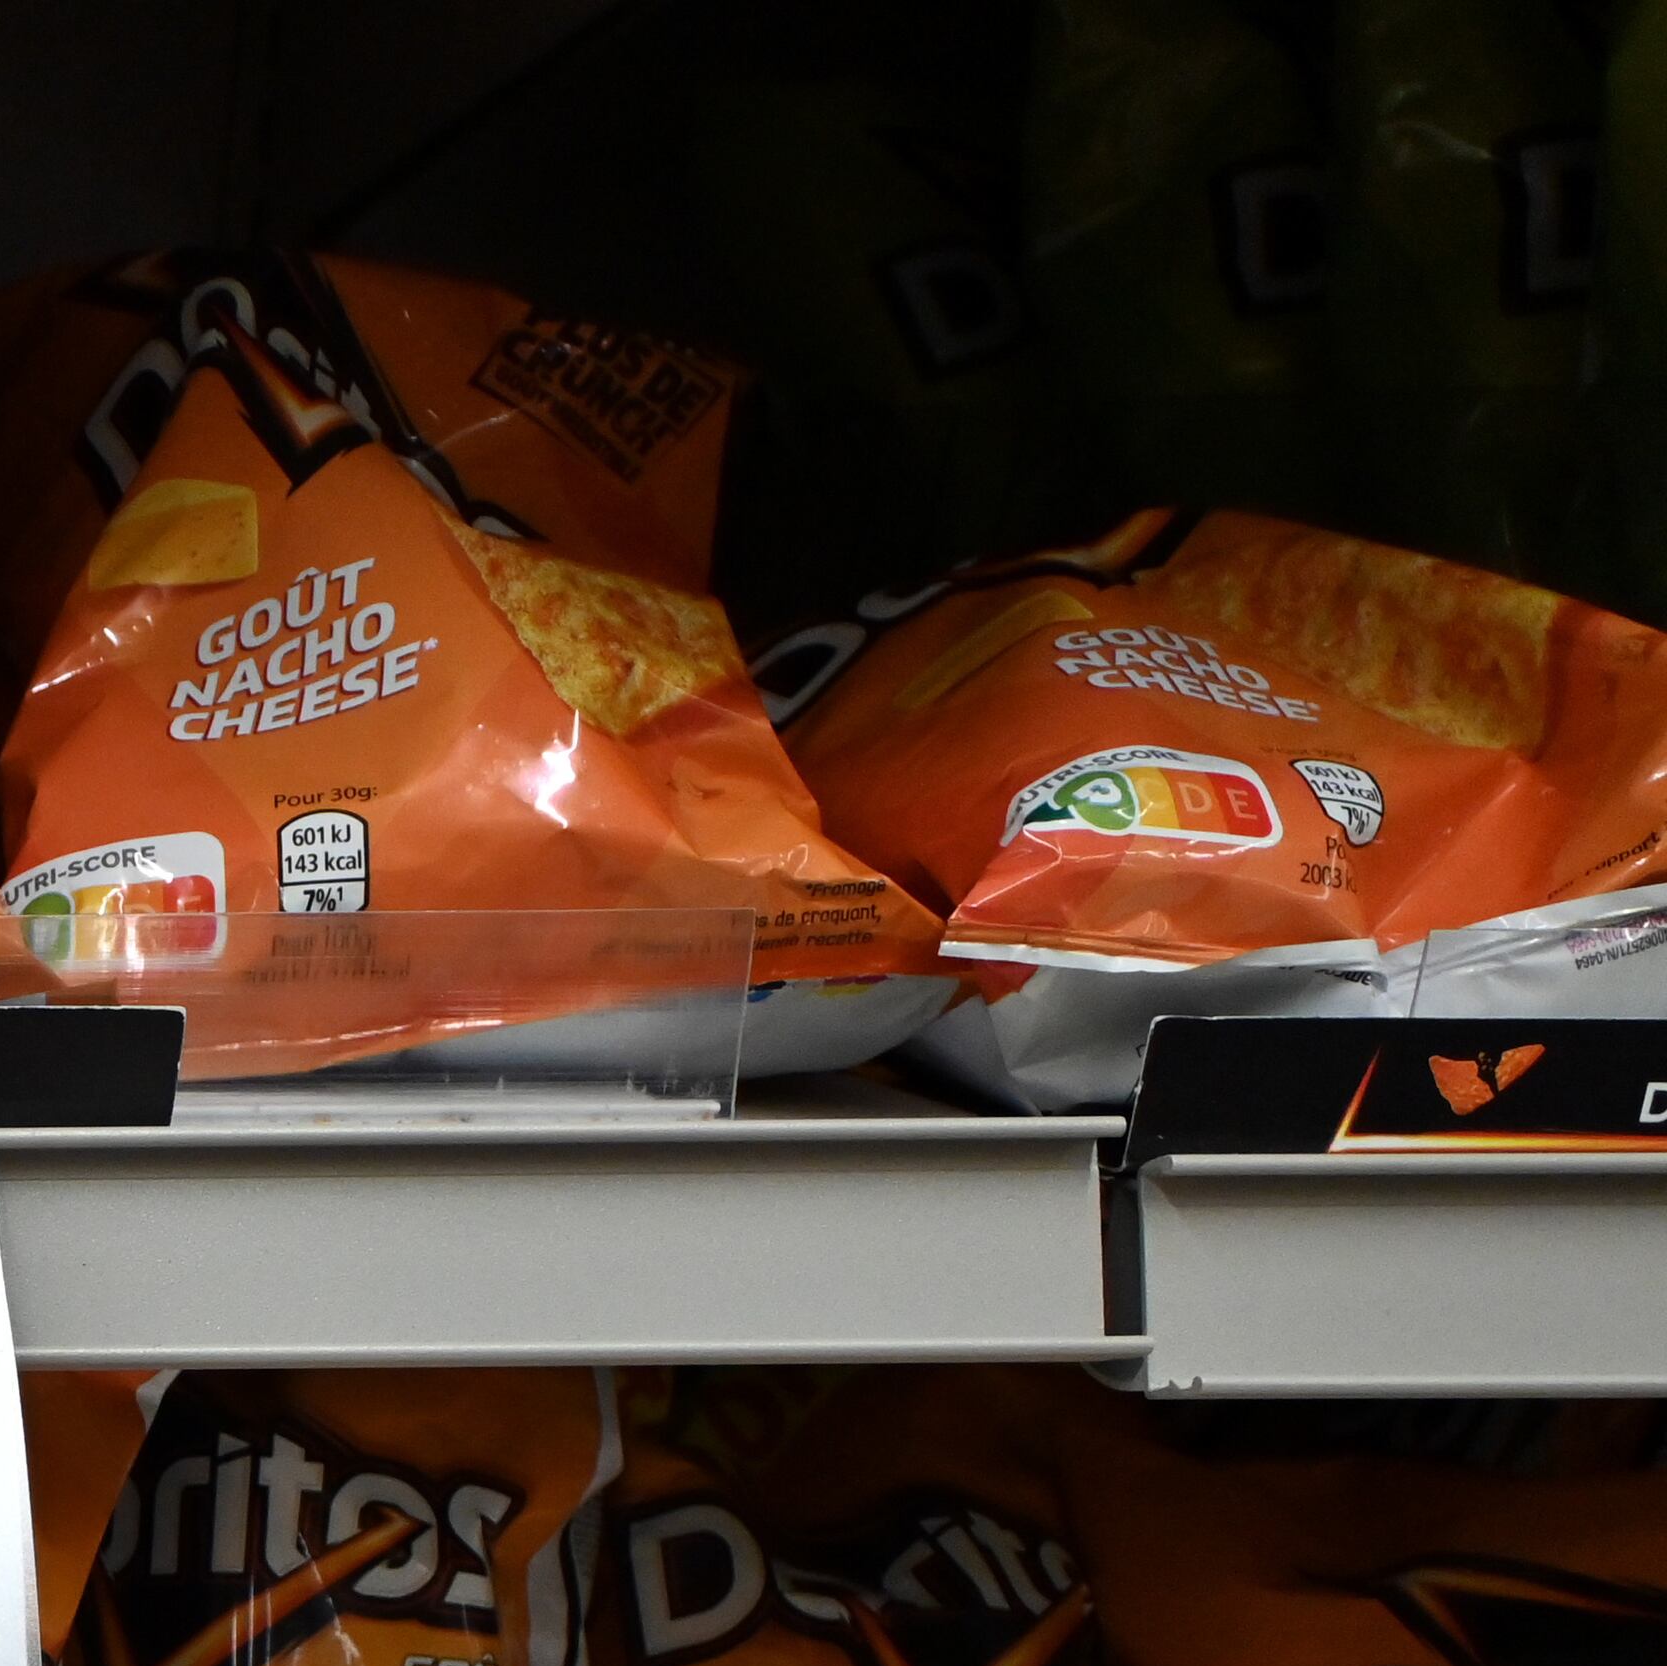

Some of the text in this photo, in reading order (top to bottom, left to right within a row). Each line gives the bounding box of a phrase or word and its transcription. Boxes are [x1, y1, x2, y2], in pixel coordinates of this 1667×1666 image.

[196, 557, 375, 667] GOÛT
[169, 601, 396, 711] NACHO
[1054, 625, 1220, 659] GOÛT
[1054, 649, 1271, 692] NACHO
[273, 784, 379, 809] Pour 30g:
[1311, 779, 1381, 803] 143 kcal
[291, 825, 353, 848] 601 kJ
[283, 851, 363, 874] 143 kcal
[1584, 830, 1660, 877] rapport
[774, 905, 796, 928] de
[800, 904, 882, 930] craquant,
